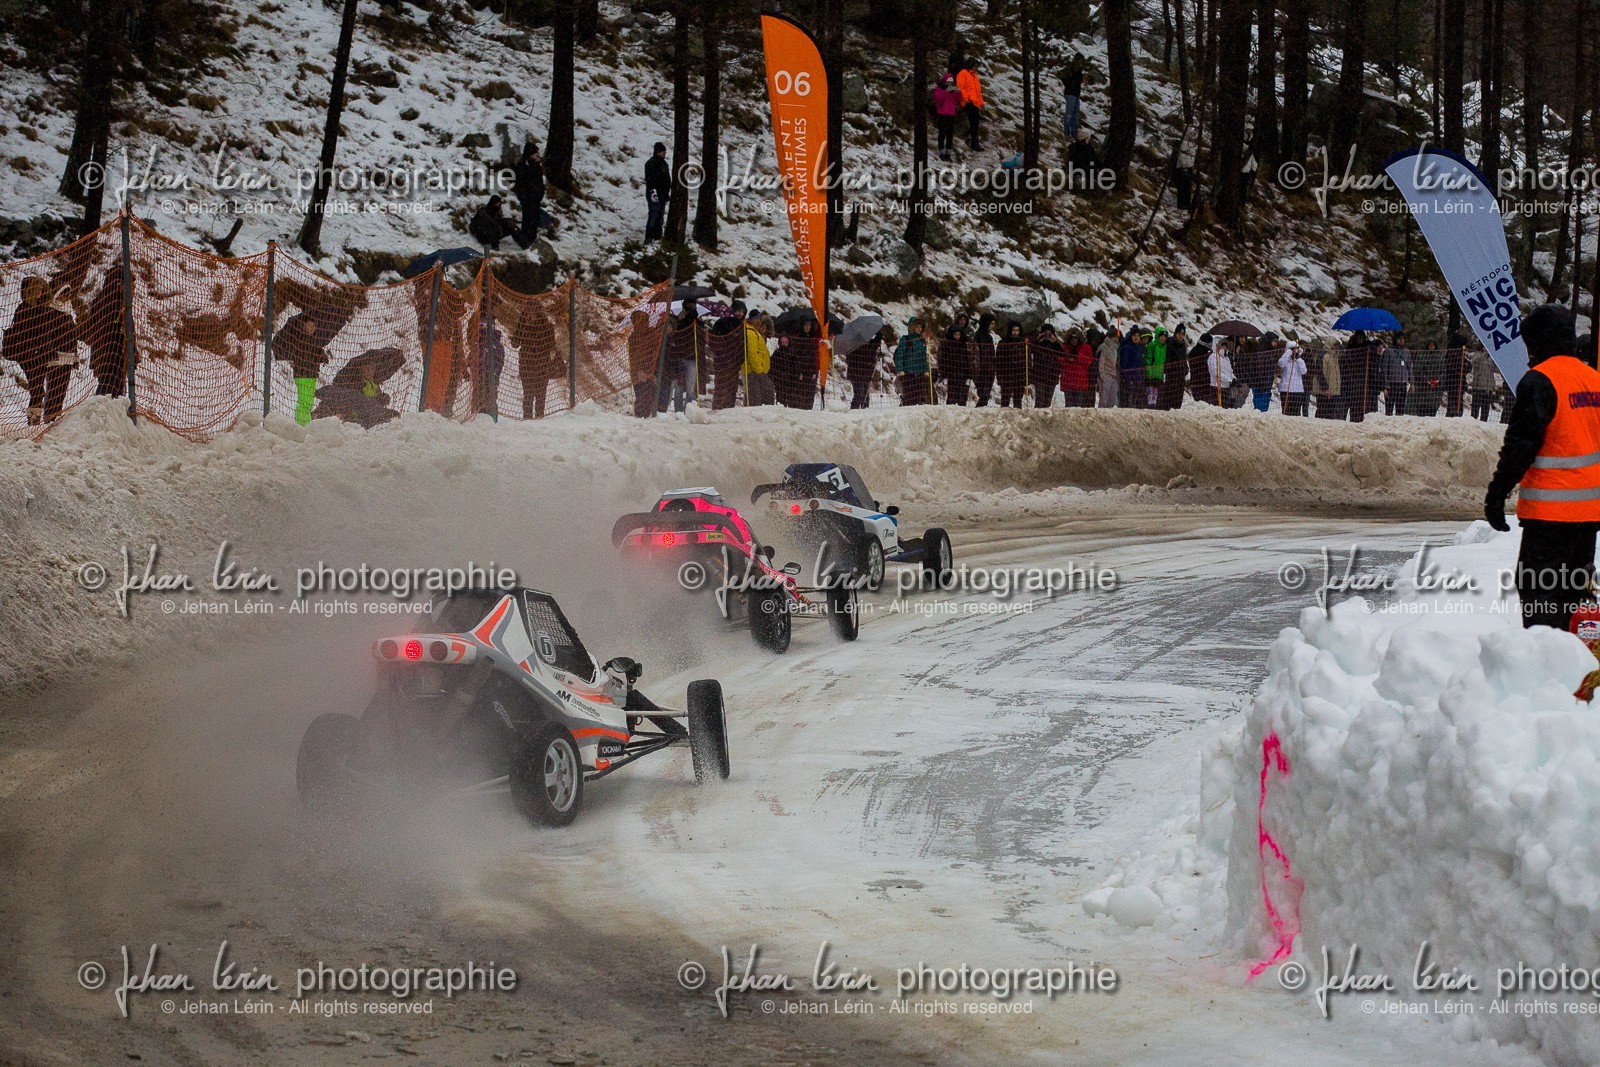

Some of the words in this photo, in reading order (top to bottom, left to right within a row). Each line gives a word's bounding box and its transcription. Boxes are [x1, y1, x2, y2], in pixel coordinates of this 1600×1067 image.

[774, 70, 811, 97] 06
[1460, 261, 1510, 297] MÉTROPO
[1466, 276, 1515, 317] NIC
[1478, 294, 1520, 332] COT
[540, 636, 554, 657] 6
